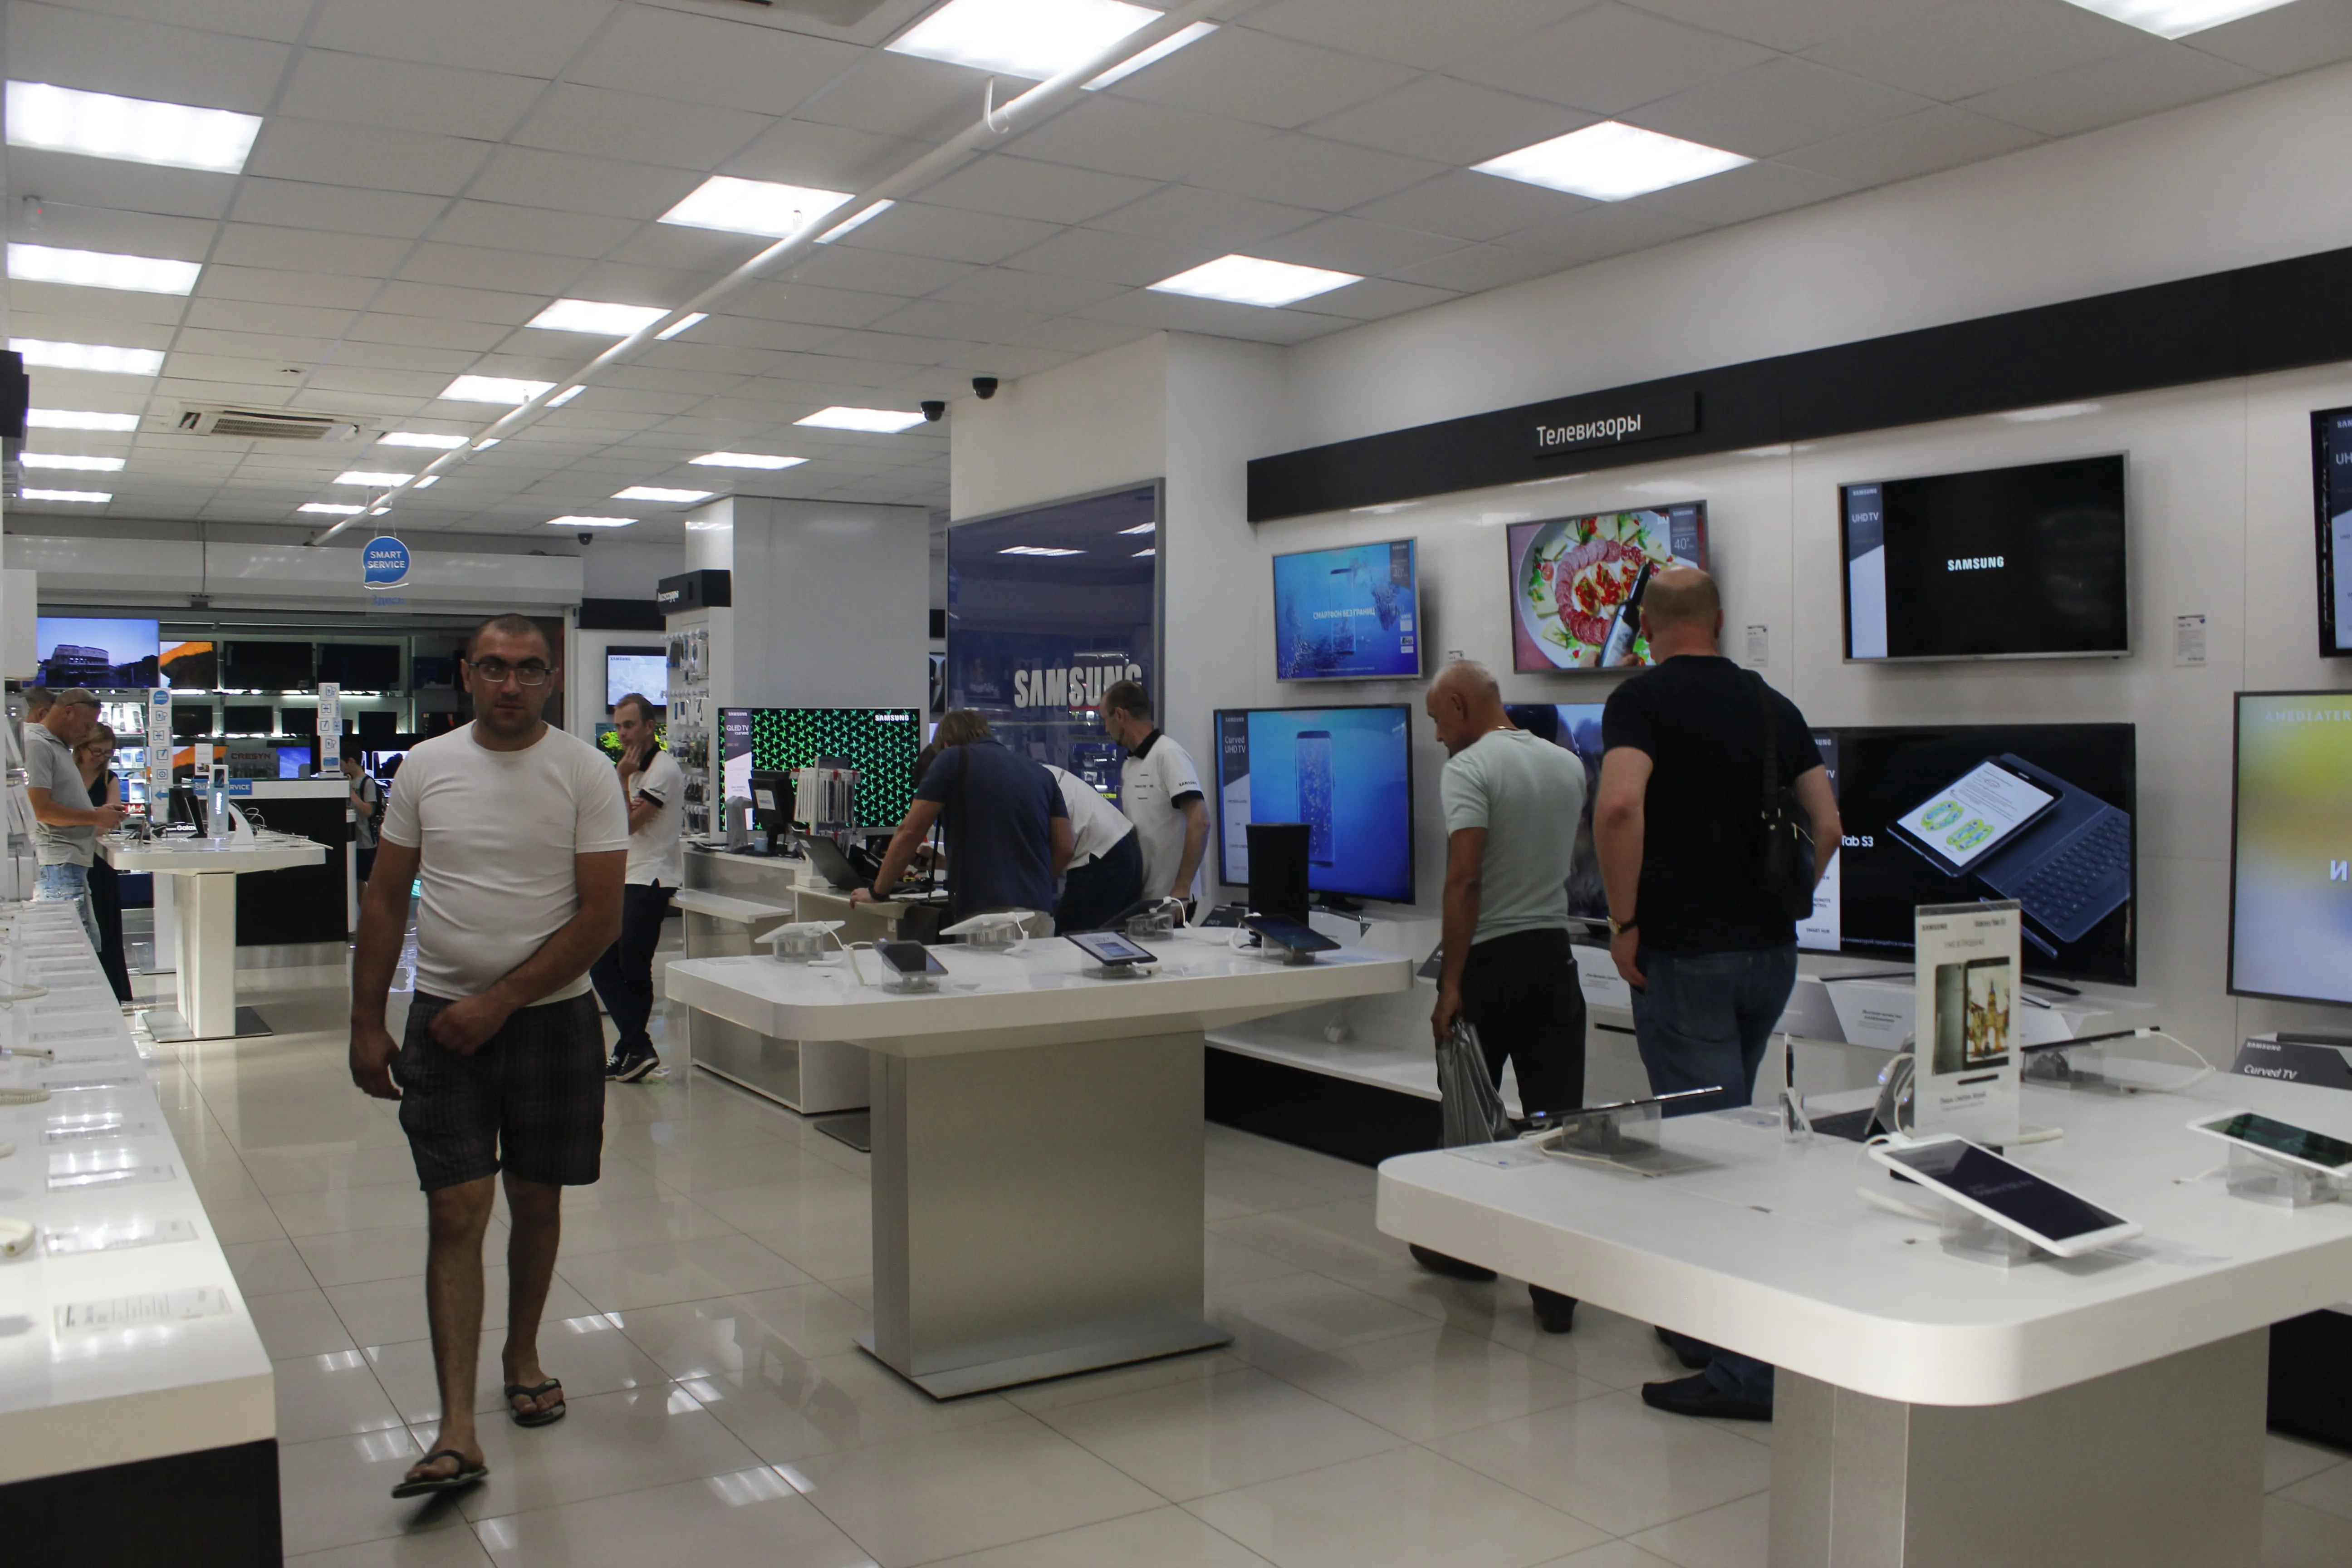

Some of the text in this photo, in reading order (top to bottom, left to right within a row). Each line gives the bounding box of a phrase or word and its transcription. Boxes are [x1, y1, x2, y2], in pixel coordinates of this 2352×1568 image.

[1536, 413, 1641, 447] Телевизоры
[1853, 488, 1877, 496] SAMSUNG
[1852, 512, 1879, 523] UHD TV
[368, 560, 406, 568] SERVICE
[1947, 556, 2004, 571] SAMSUNG
[1313, 609, 1342, 620] СМАРТФОН
[1225, 735, 1245, 744] Curved
[1225, 745, 1245, 754] UHD TV
[1862, 836, 1873, 847] S3
[2246, 1041, 2282, 1052] SAMSUNG
[2244, 1064, 2298, 1079] Curved TV
